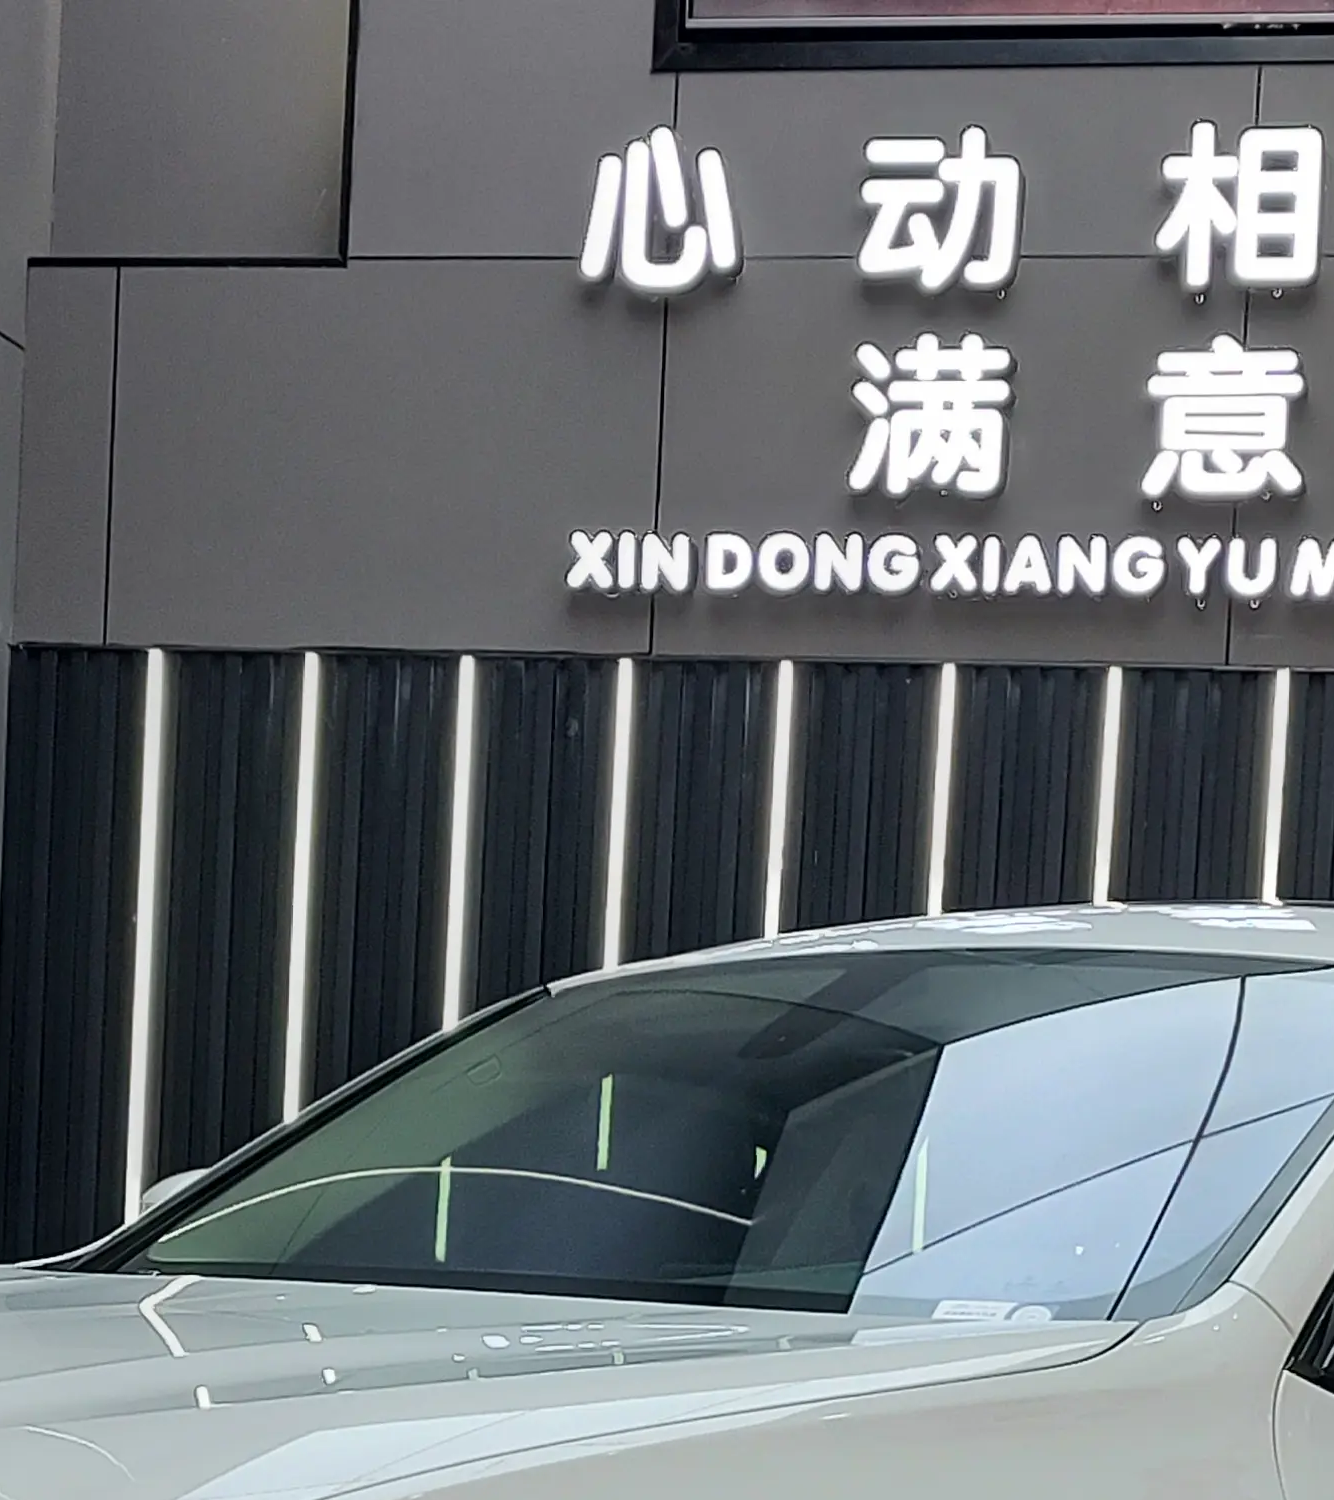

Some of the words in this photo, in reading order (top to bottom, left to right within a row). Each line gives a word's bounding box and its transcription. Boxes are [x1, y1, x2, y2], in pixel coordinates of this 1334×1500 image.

[565, 529, 692, 592] XIN
[705, 531, 921, 593] DONG
[929, 533, 1166, 595] XIANG
[1176, 535, 1278, 597] YU
